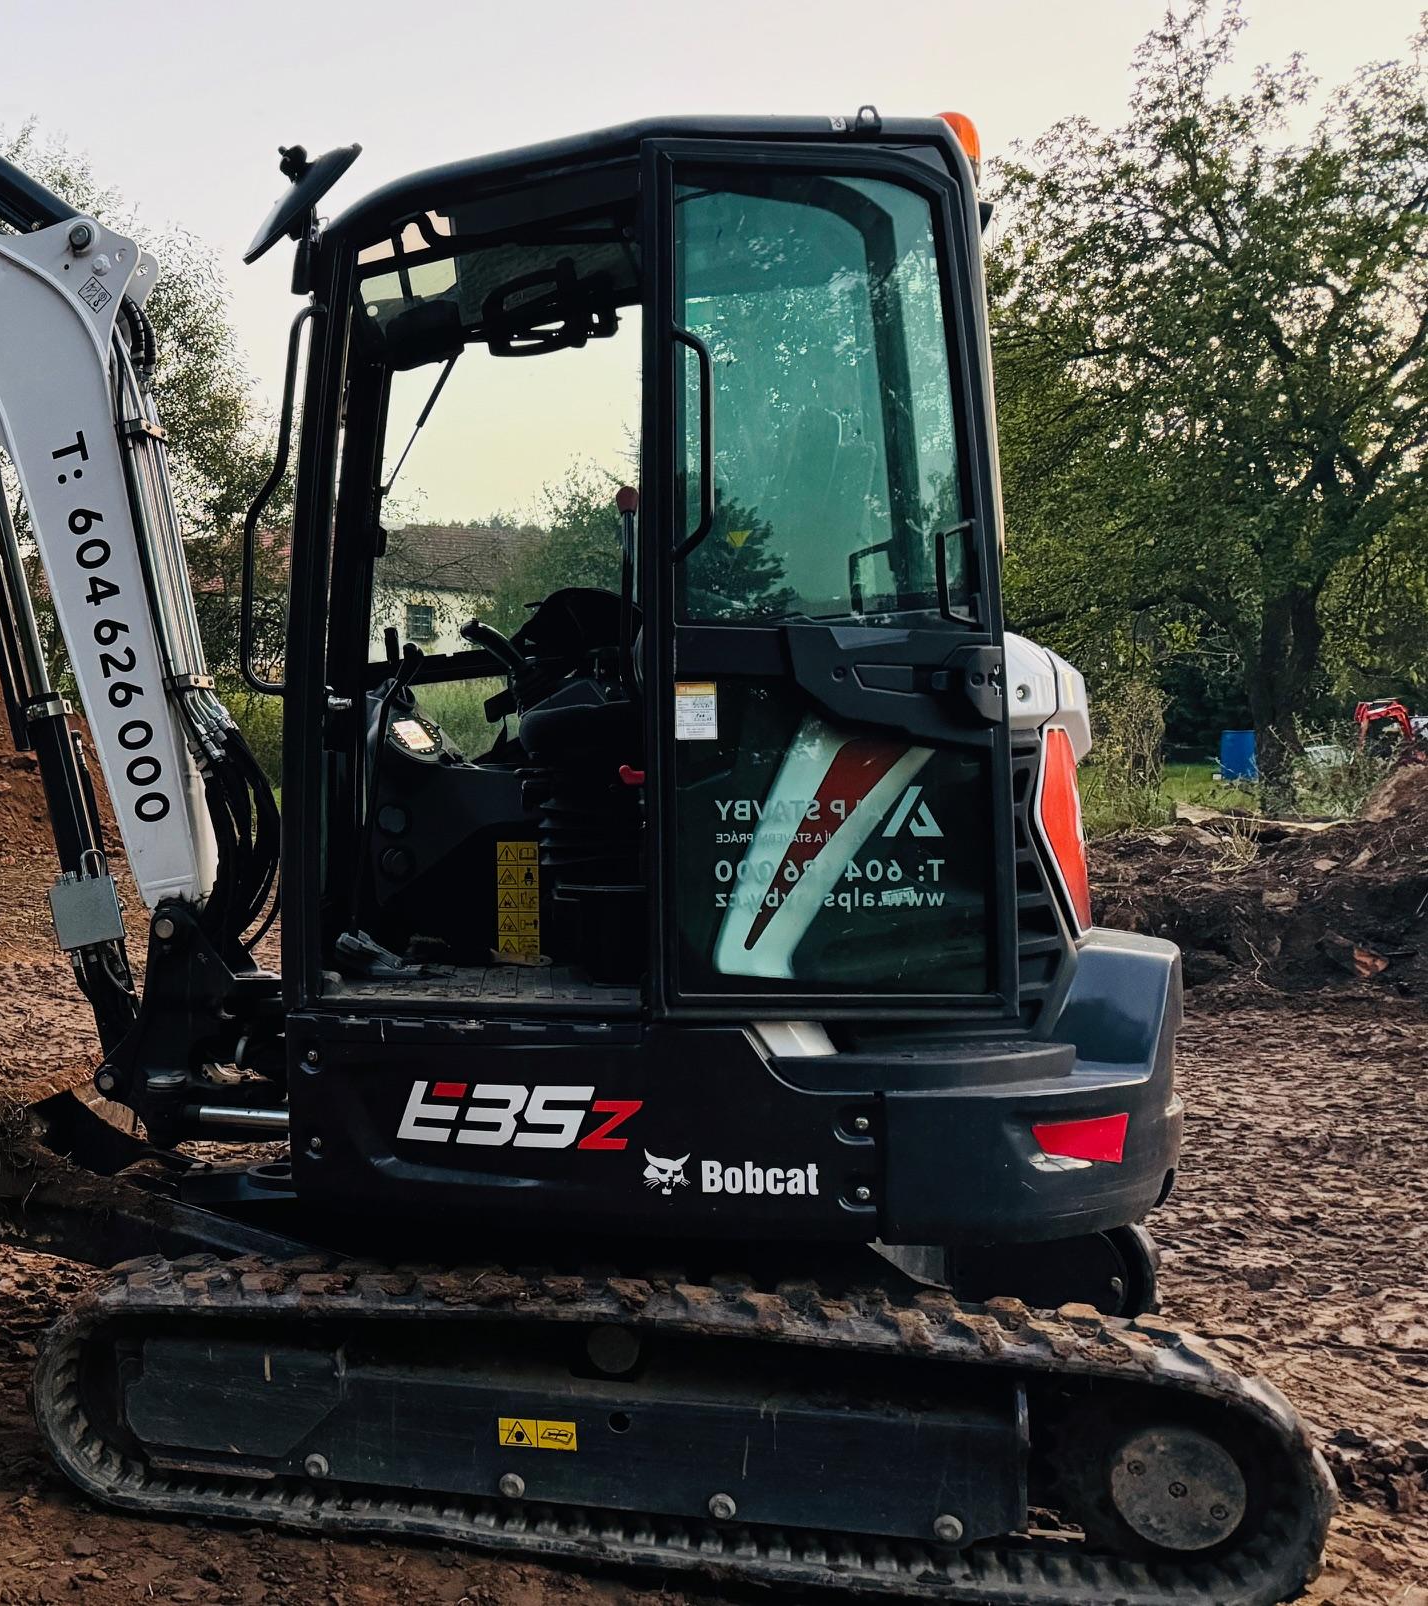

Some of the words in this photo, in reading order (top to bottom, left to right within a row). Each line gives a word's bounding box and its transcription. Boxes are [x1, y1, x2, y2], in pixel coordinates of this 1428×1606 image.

[51, 430, 90, 485] T:
[68, 507, 120, 607] 604
[93, 618, 144, 709] 626
[117, 719, 170, 823] 000
[701, 1160, 820, 1196] Bobcat
